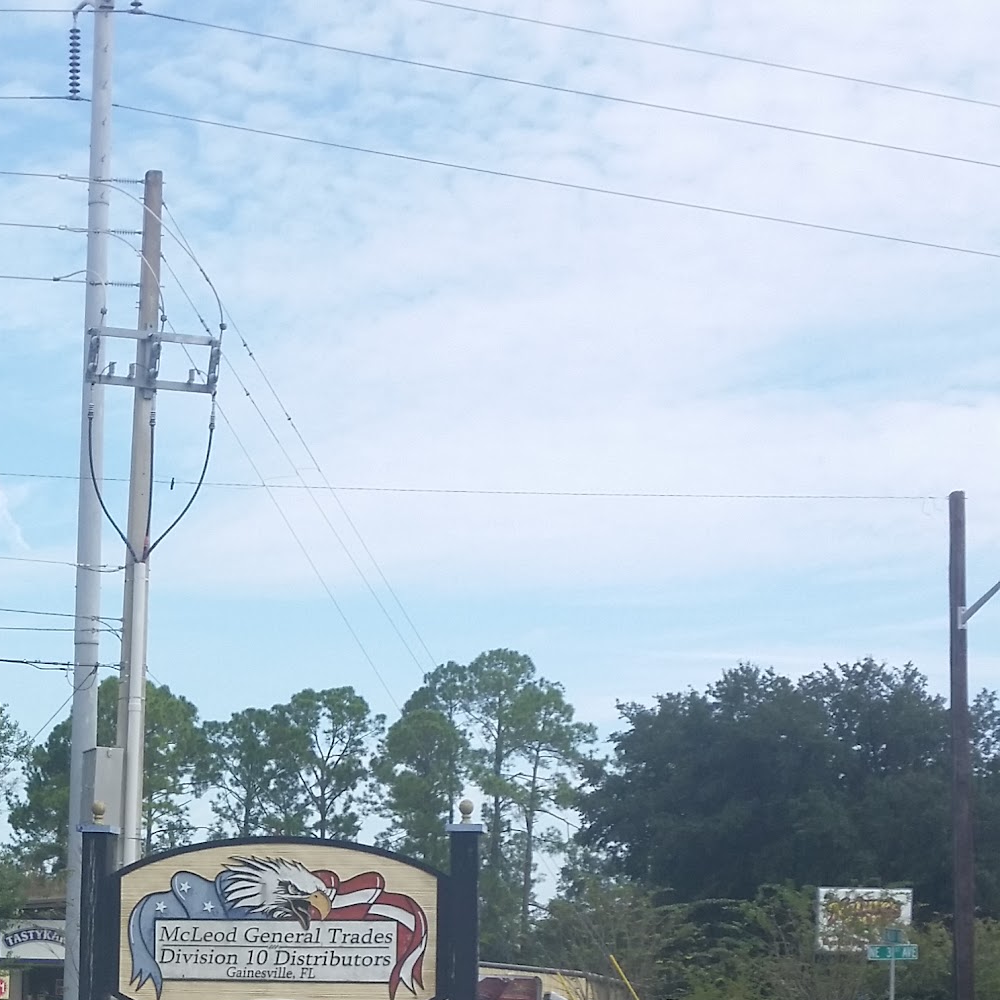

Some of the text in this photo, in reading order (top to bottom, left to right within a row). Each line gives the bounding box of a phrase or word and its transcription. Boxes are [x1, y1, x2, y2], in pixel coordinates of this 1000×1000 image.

[159, 926, 394, 944] McLeod General Trades
[159, 948, 391, 967] Division 10 Distributors
[226, 966, 316, 979] Gainesville, FL
